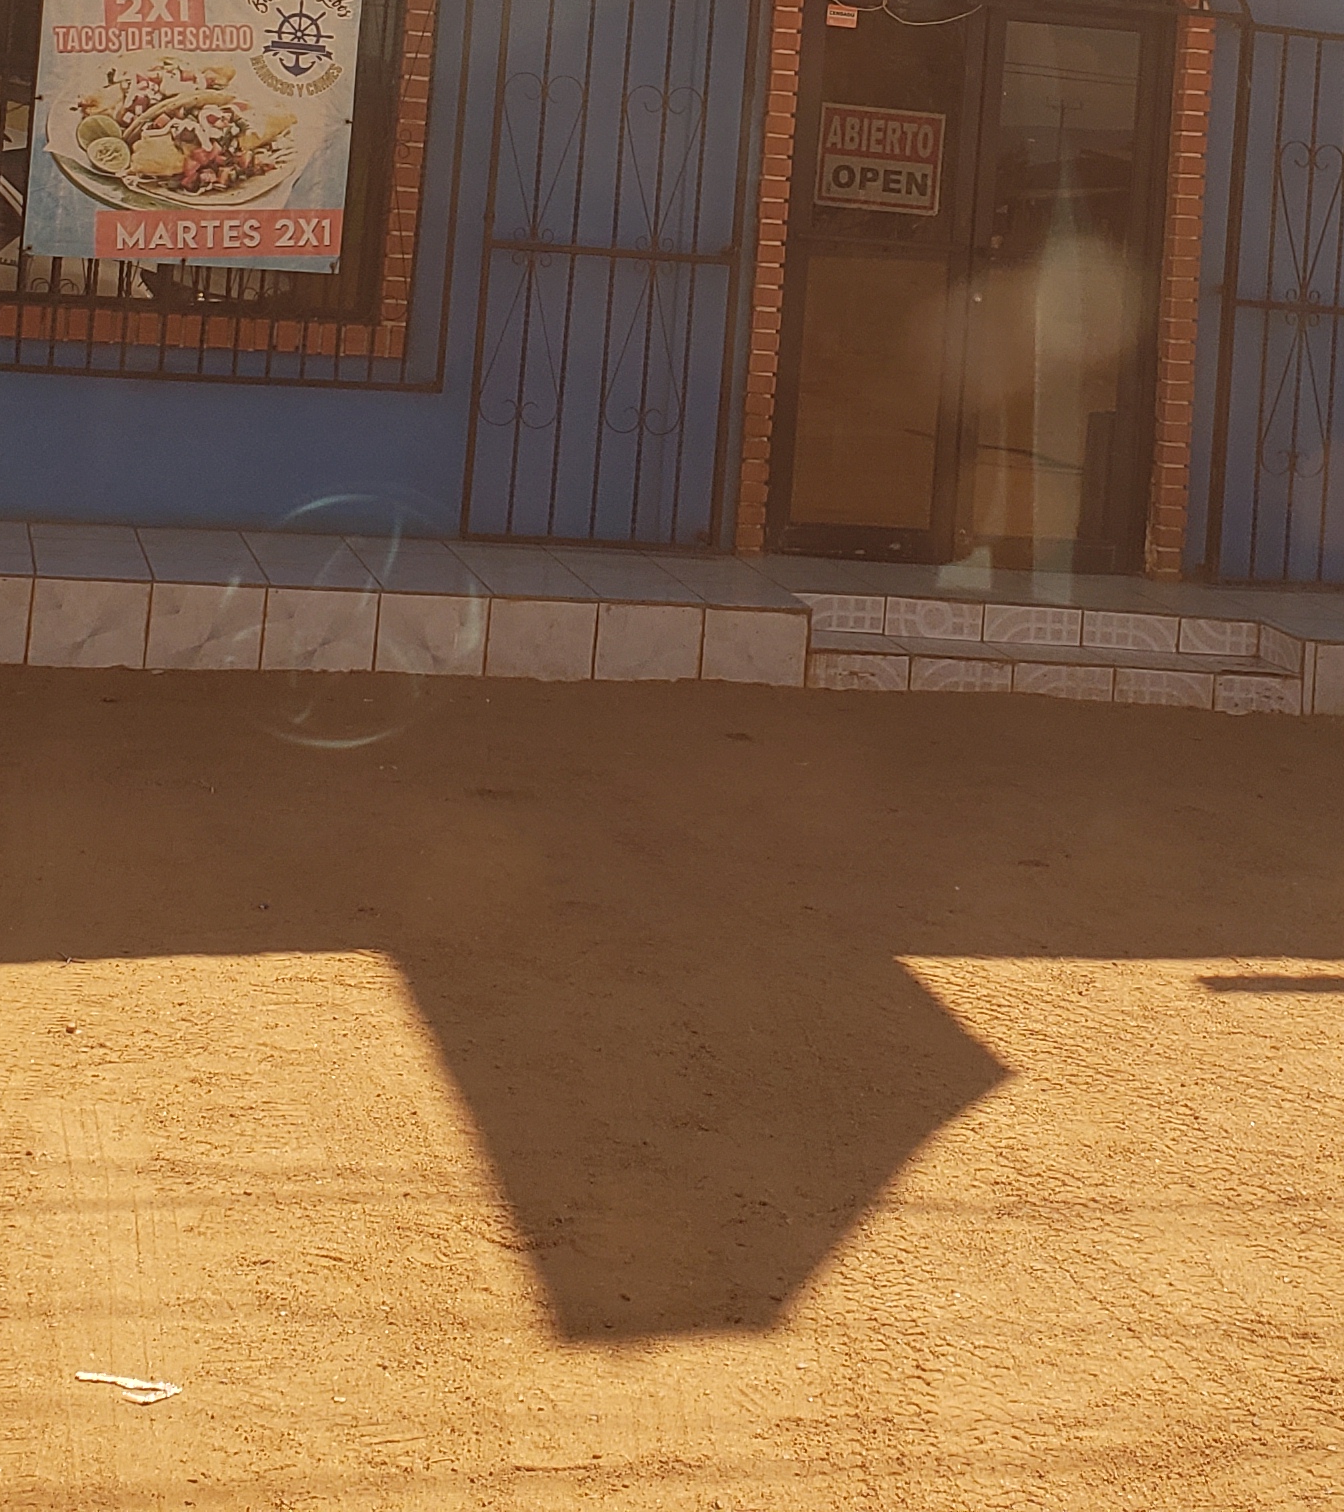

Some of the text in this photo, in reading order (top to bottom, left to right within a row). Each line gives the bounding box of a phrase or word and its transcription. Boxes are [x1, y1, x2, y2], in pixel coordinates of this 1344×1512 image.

[55, 26, 254, 52] TACOS DE PESCADO
[826, 115, 934, 159] ABIERTO
[831, 165, 928, 197] OPEN
[116, 218, 332, 250] MARTES 2X1
